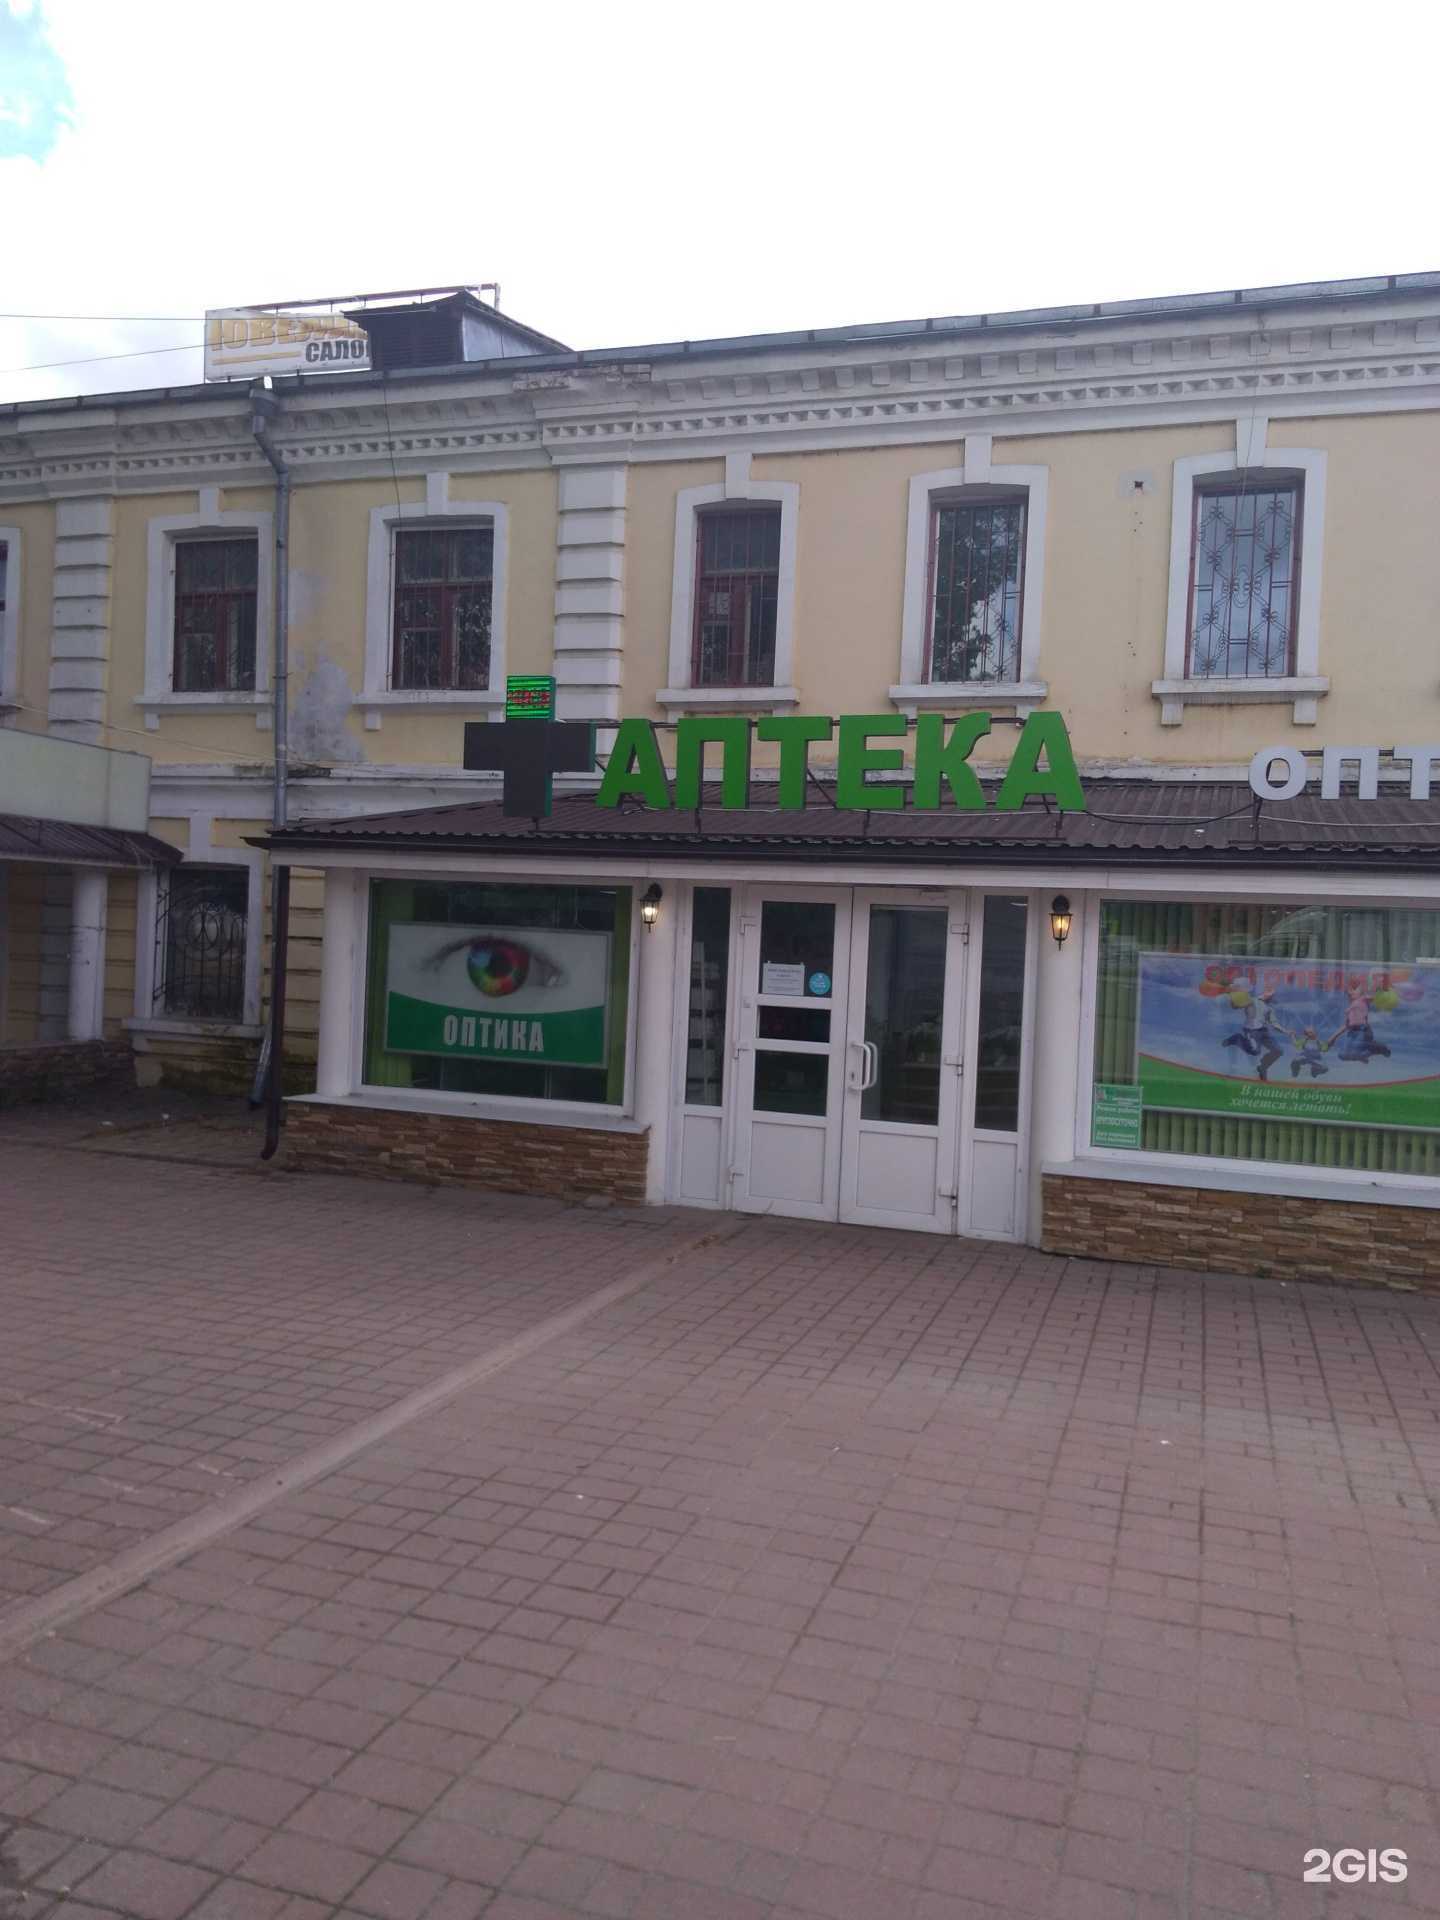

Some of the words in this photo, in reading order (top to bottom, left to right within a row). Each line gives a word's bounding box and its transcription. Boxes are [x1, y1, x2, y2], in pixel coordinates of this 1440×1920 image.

[596, 711, 1087, 811] АПТЕКА
[1249, 746, 1440, 800] ОПТ
[443, 1014, 545, 1052] ОПТИКА
